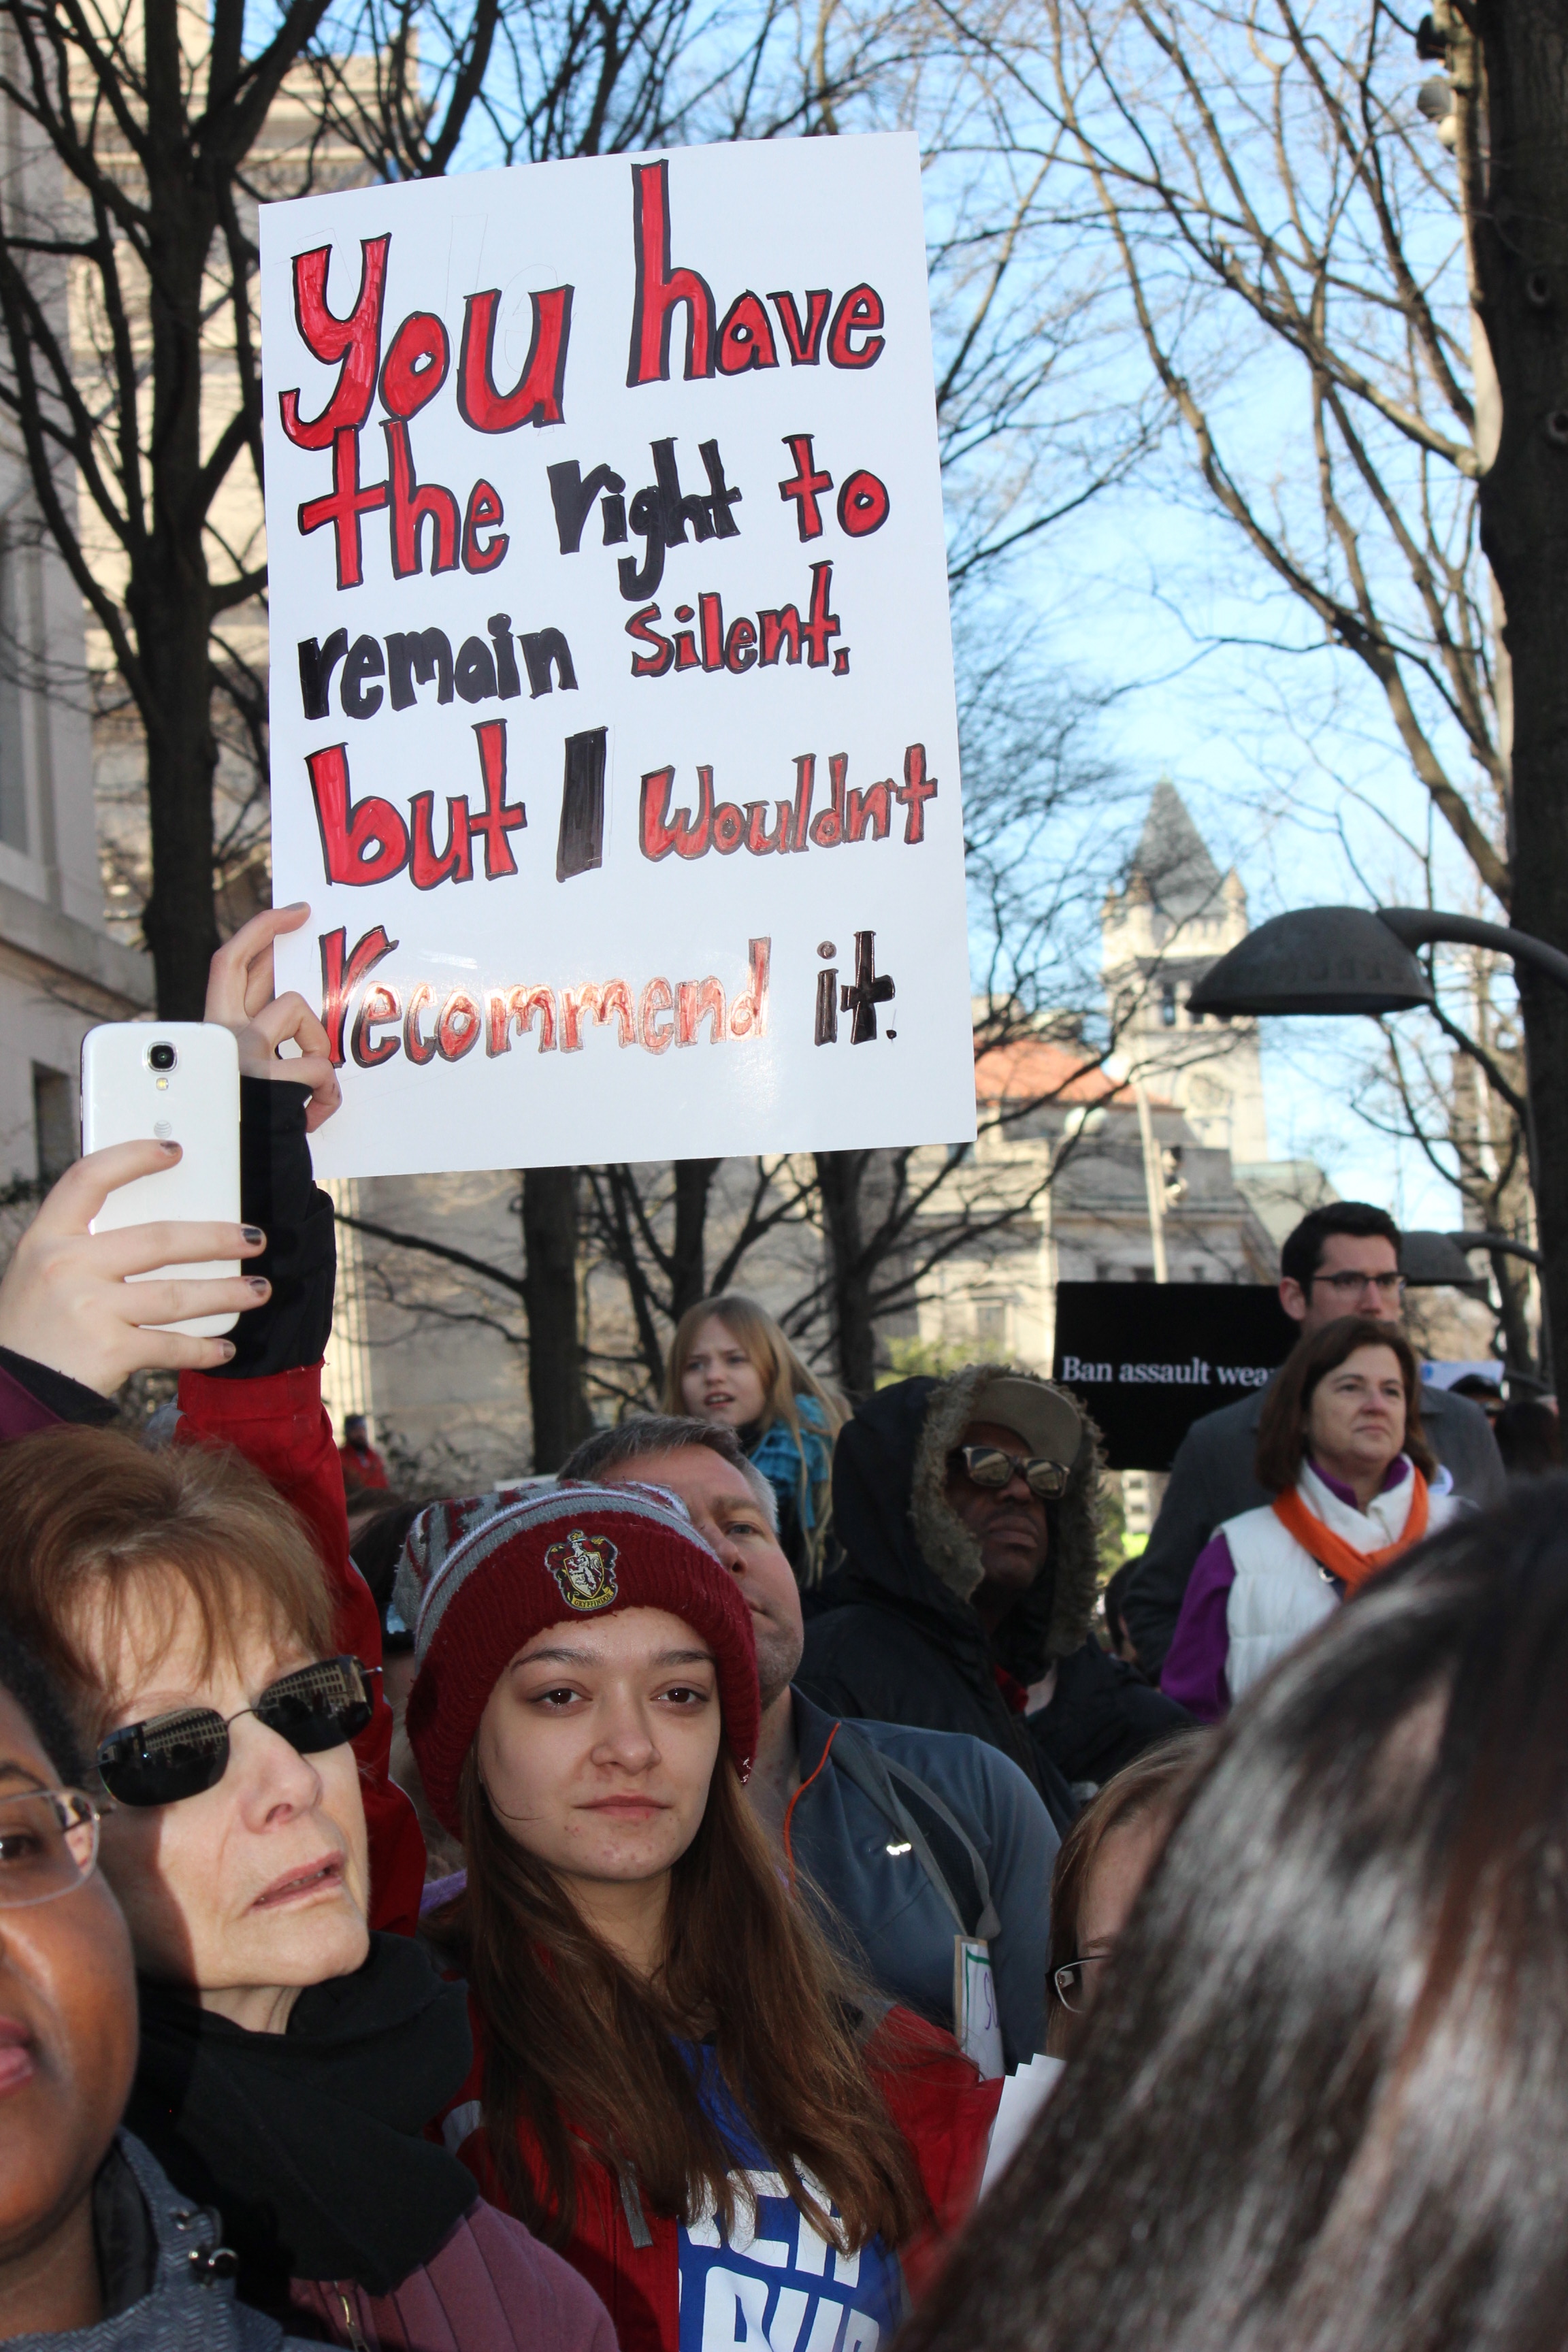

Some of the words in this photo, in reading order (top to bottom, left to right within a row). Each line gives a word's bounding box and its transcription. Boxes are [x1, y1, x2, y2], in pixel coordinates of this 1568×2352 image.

[626, 159, 886, 388] have
[297, 417, 510, 591] the
[546, 437, 743, 602] right
[779, 434, 891, 543] to
[297, 613, 579, 720] remain
[304, 718, 527, 891] but
[556, 726, 608, 883] I
[318, 925, 772, 1068] recommend
[815, 931, 897, 1047] it.
[1062, 1356, 1112, 1382] Ban
[1120, 1357, 1211, 1385] assault
[1215, 1365, 1275, 1387] wea
[574, 1593, 612, 1607] GRYFFINDOR
